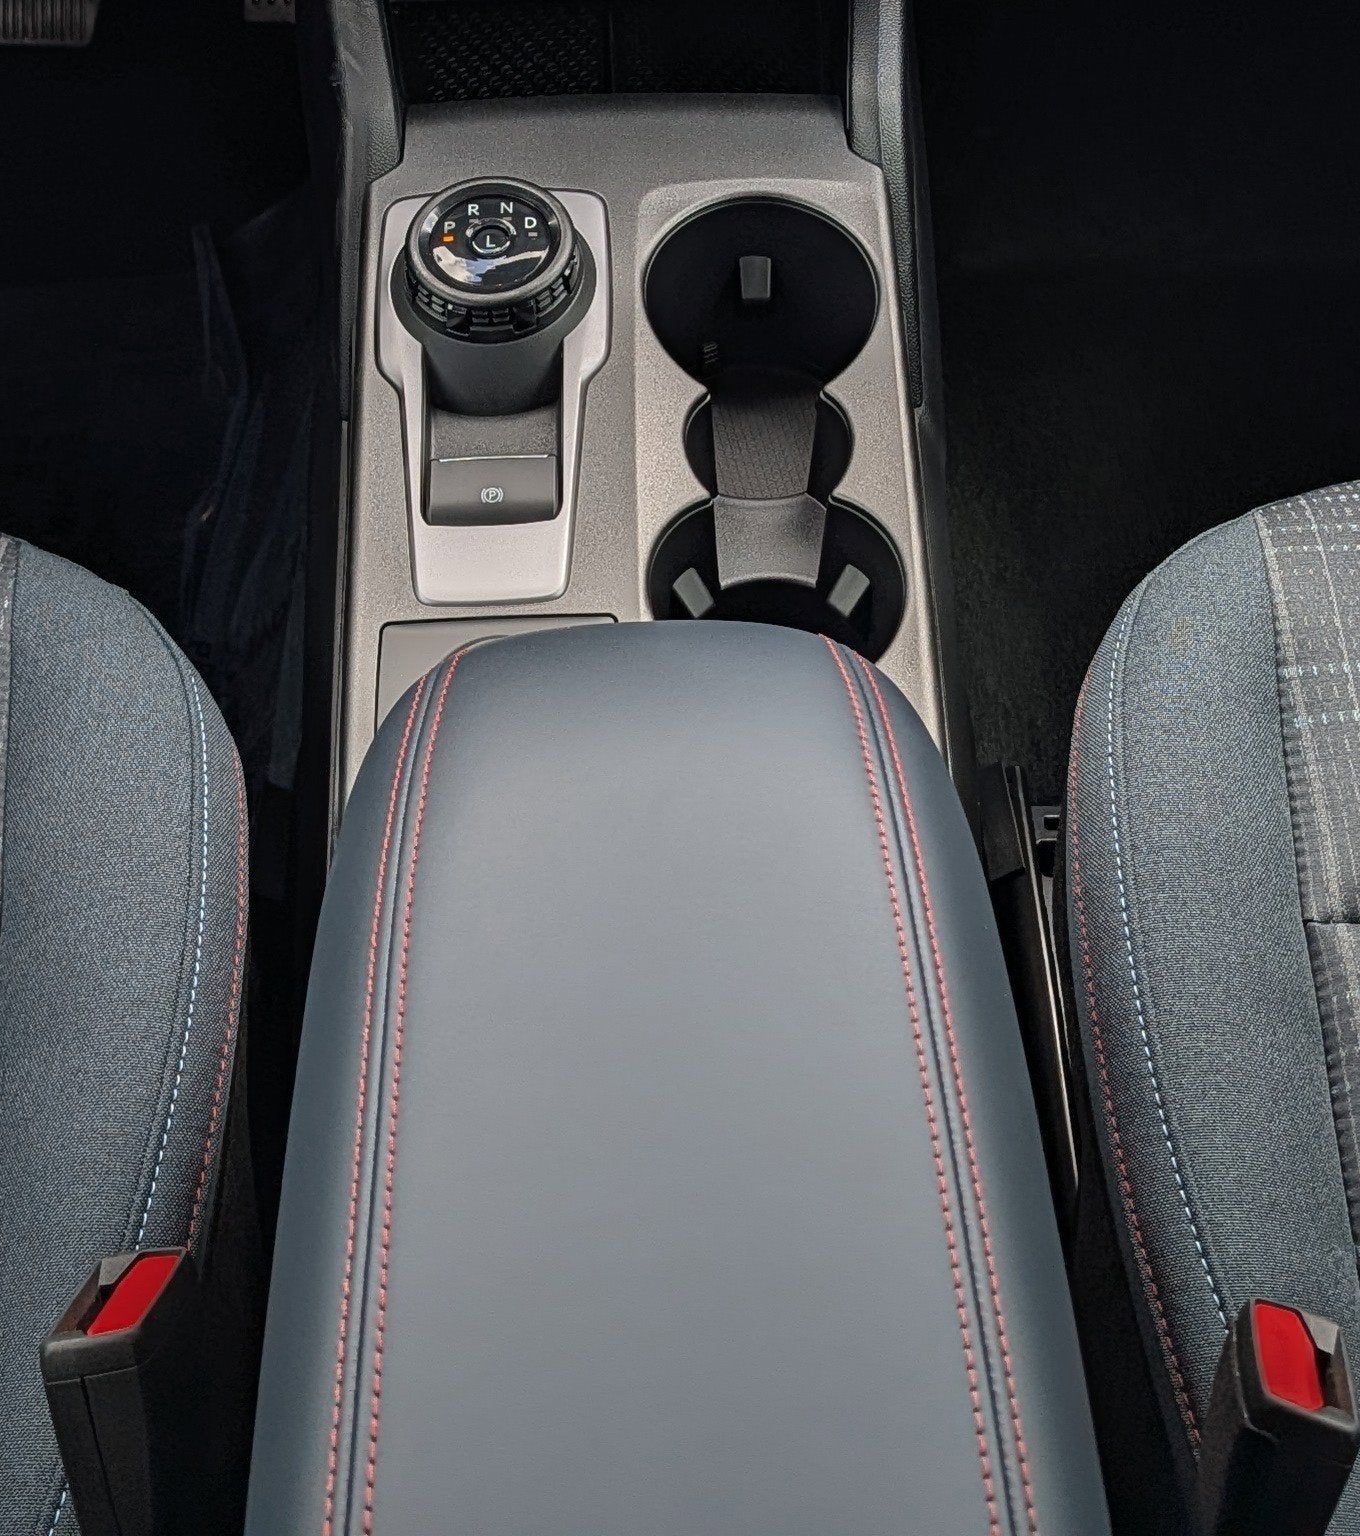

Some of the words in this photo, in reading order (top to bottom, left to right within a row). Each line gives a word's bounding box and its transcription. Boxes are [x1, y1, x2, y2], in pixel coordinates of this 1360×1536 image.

[467, 203, 480, 216] R
[500, 201, 514, 214] N
[443, 220, 456, 234] P
[524, 216, 537, 229] D
[486, 234, 496, 248] L
